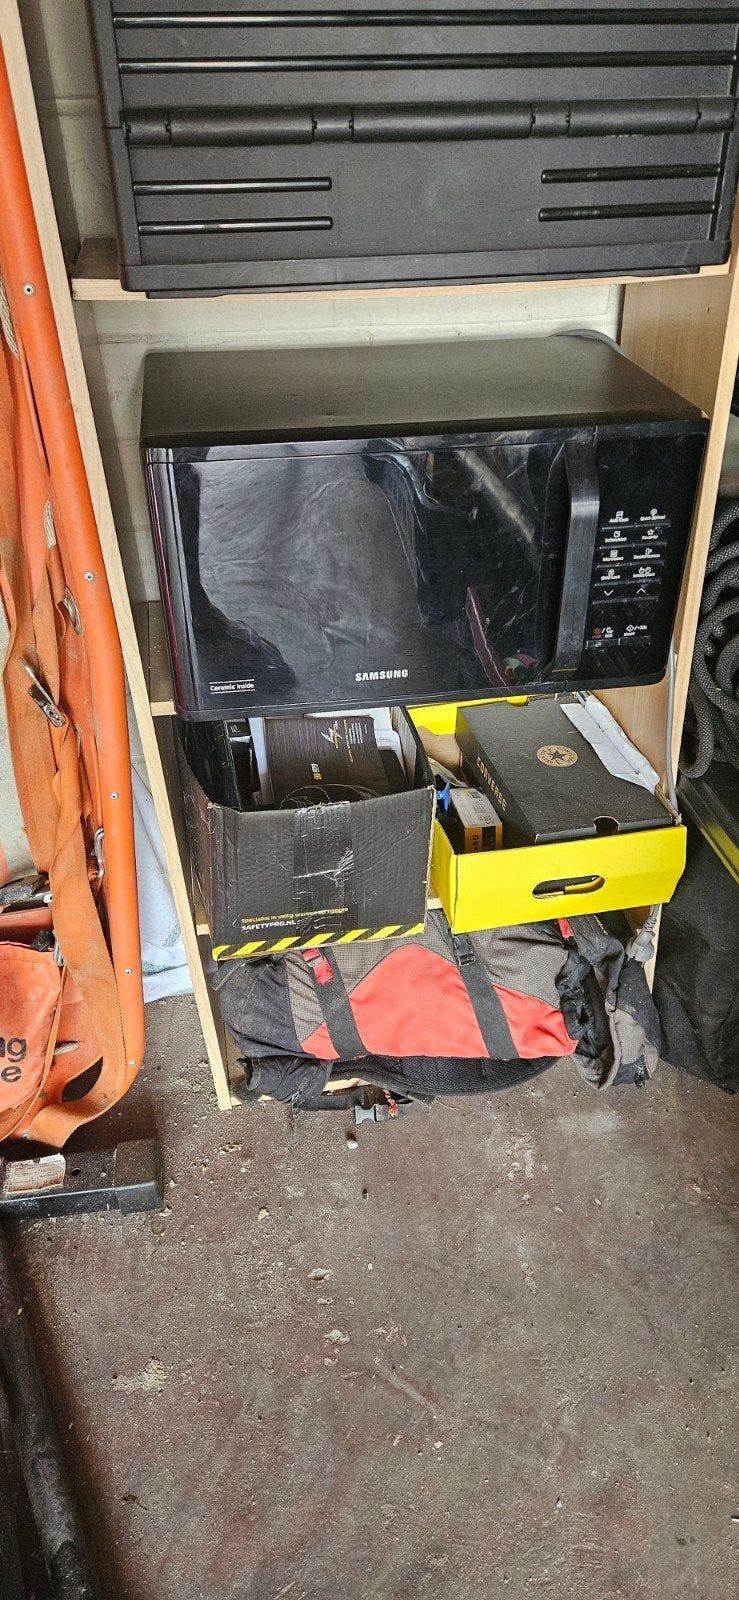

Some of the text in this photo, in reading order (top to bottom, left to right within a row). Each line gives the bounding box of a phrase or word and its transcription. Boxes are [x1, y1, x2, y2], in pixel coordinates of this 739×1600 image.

[355, 669, 409, 682] SAMSUNG
[210, 682, 255, 691] Ceramic Inside
[476, 756, 507, 811] CONVERSE
[241, 919, 297, 931] SAFETYPRO.NL
